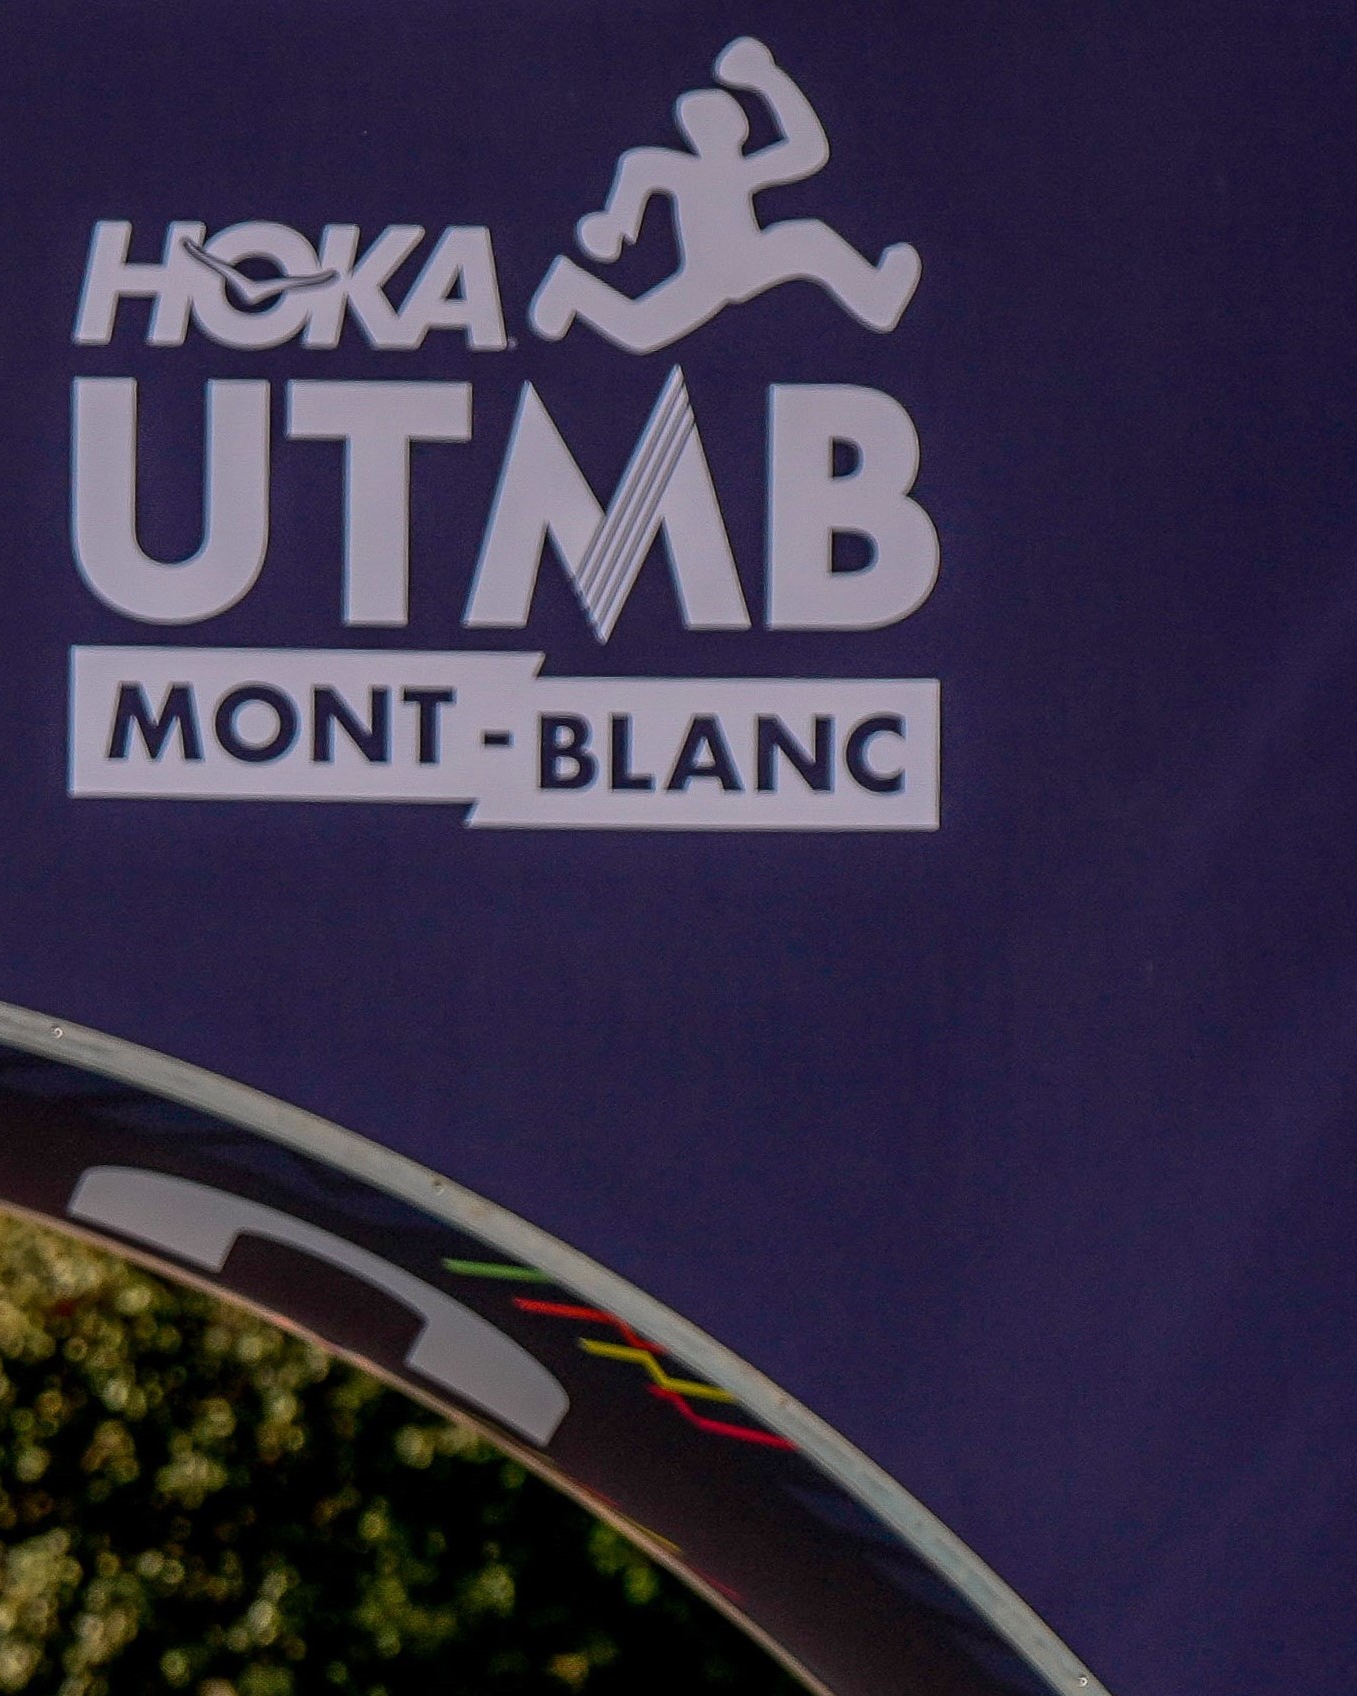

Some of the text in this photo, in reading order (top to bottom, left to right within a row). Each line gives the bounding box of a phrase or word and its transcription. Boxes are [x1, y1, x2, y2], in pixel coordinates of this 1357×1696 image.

[72, 219, 508, 351] HOKA
[72, 362, 941, 644] UTMB
[106, 680, 907, 795] MONT-BLANC
